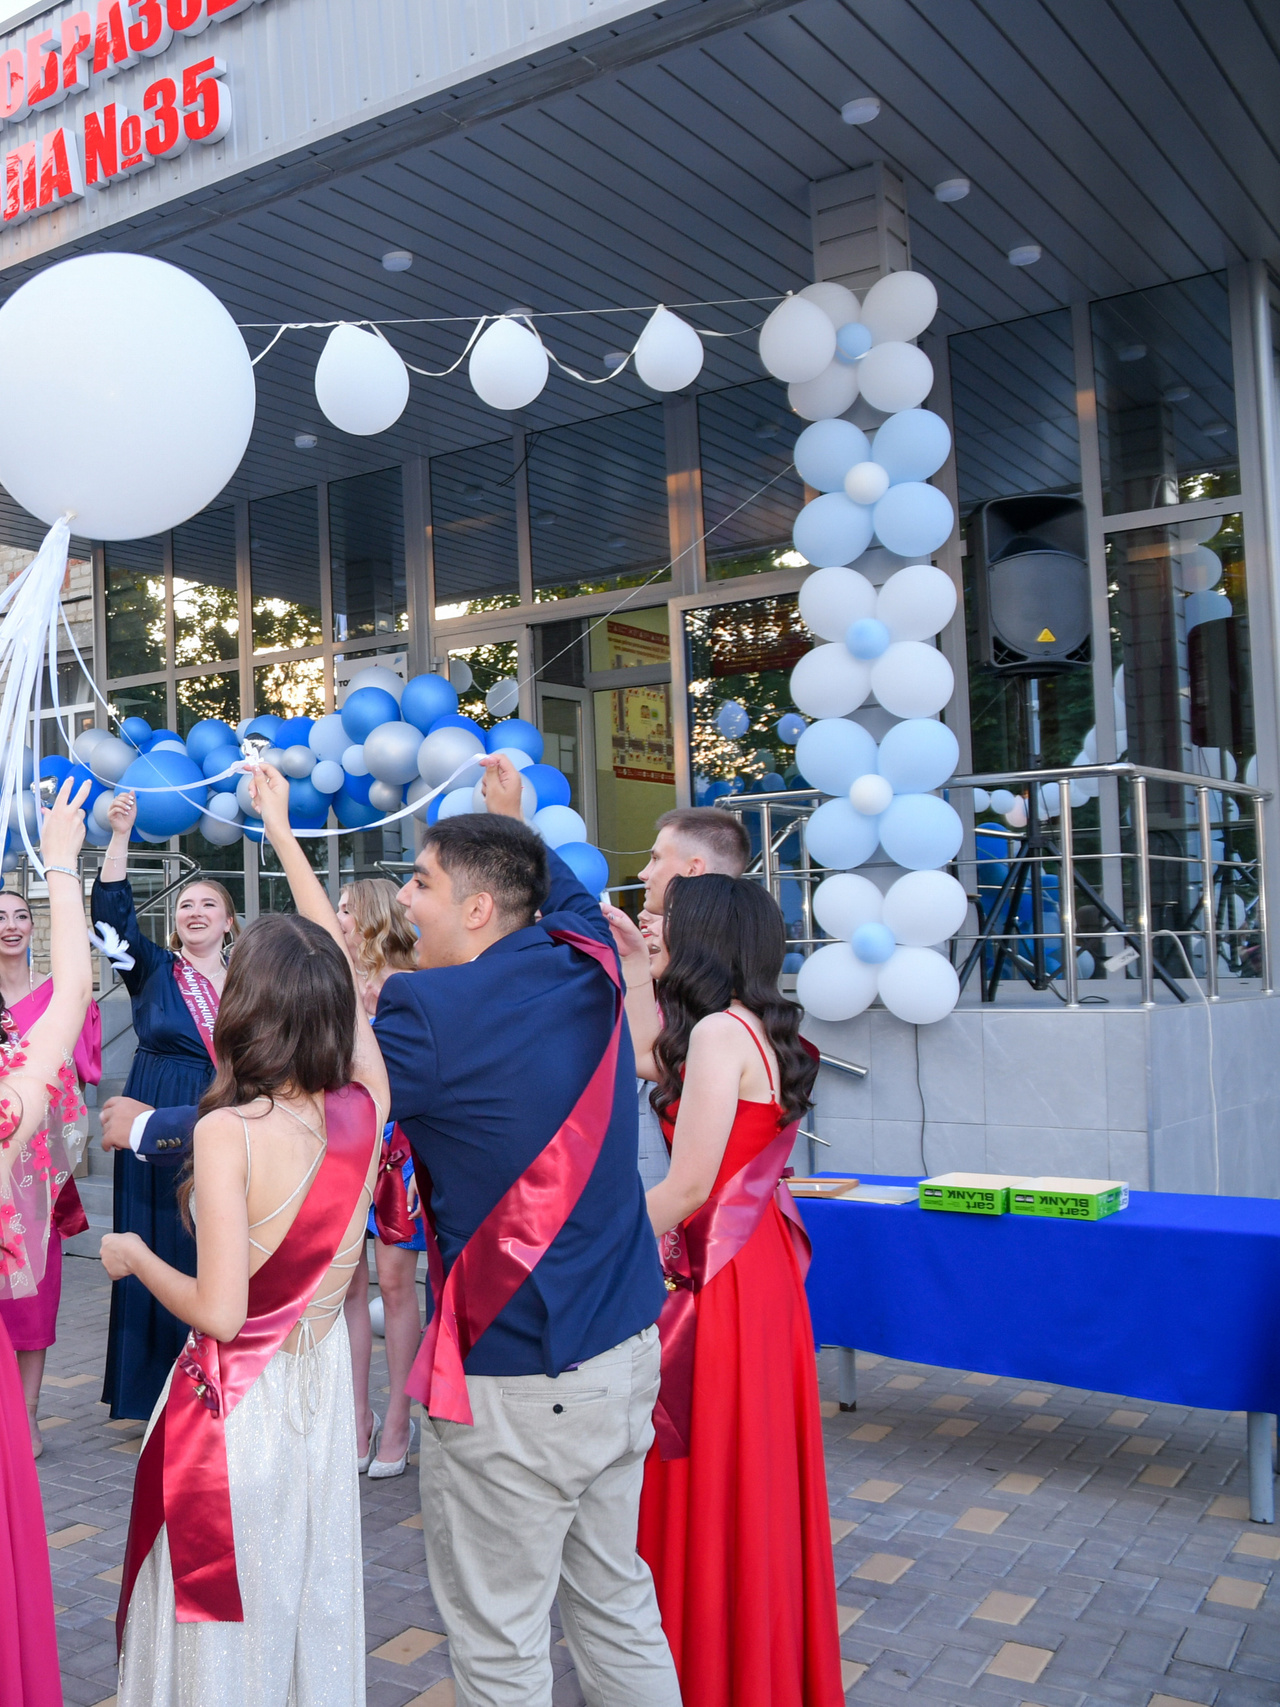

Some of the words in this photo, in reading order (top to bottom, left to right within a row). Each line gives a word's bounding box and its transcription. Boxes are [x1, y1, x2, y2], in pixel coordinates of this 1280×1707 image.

[84, 56, 222, 186] №35
[947, 1189, 994, 1201] BLANK
[966, 1200, 995, 1210] cart
[1039, 1195, 1089, 1208] BLANK
[1059, 1207, 1089, 1216] cart
